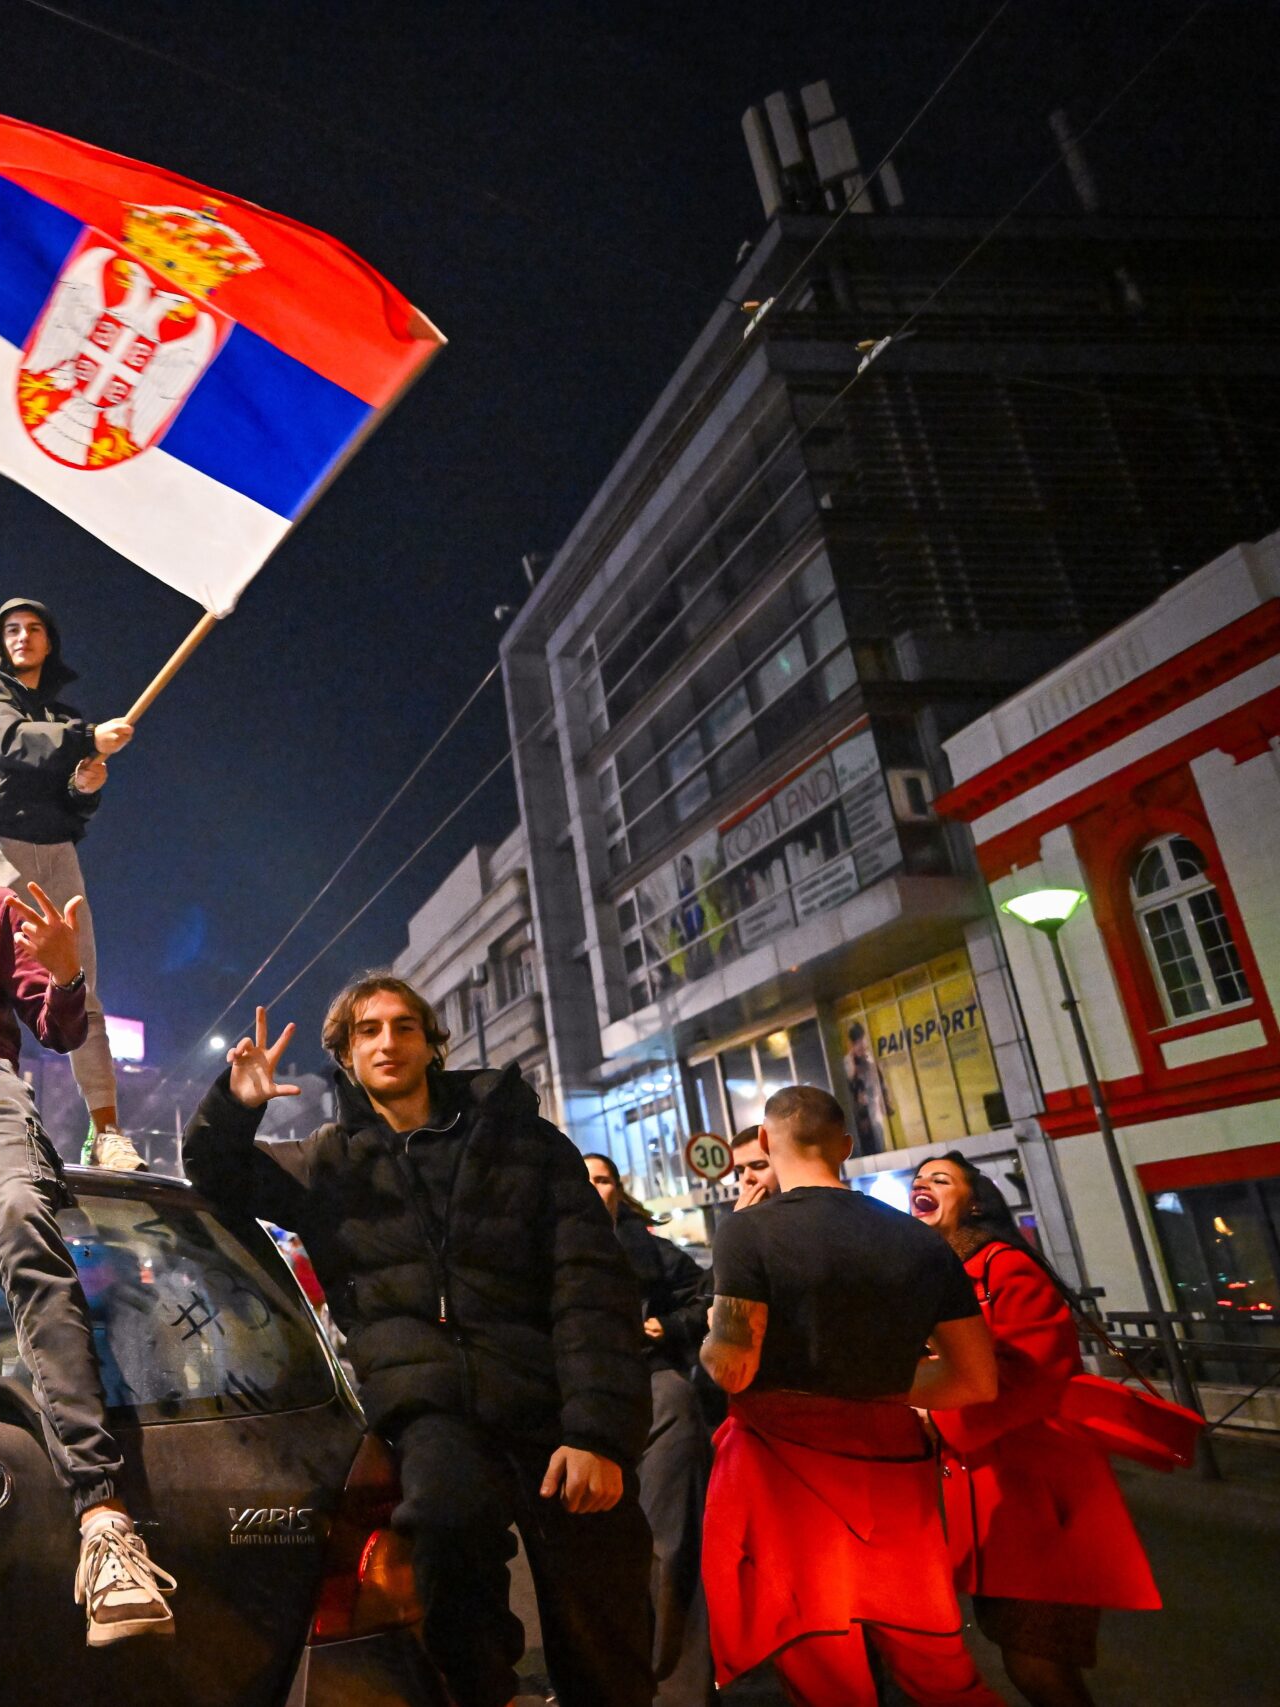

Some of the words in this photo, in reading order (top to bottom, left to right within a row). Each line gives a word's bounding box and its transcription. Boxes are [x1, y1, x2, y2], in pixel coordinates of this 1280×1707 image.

[877, 1004, 978, 1057] PANSPORT
[695, 1145, 725, 1168] 30
[230, 1534, 271, 1545] LIMITED
[274, 1534, 316, 1545] EDITION
